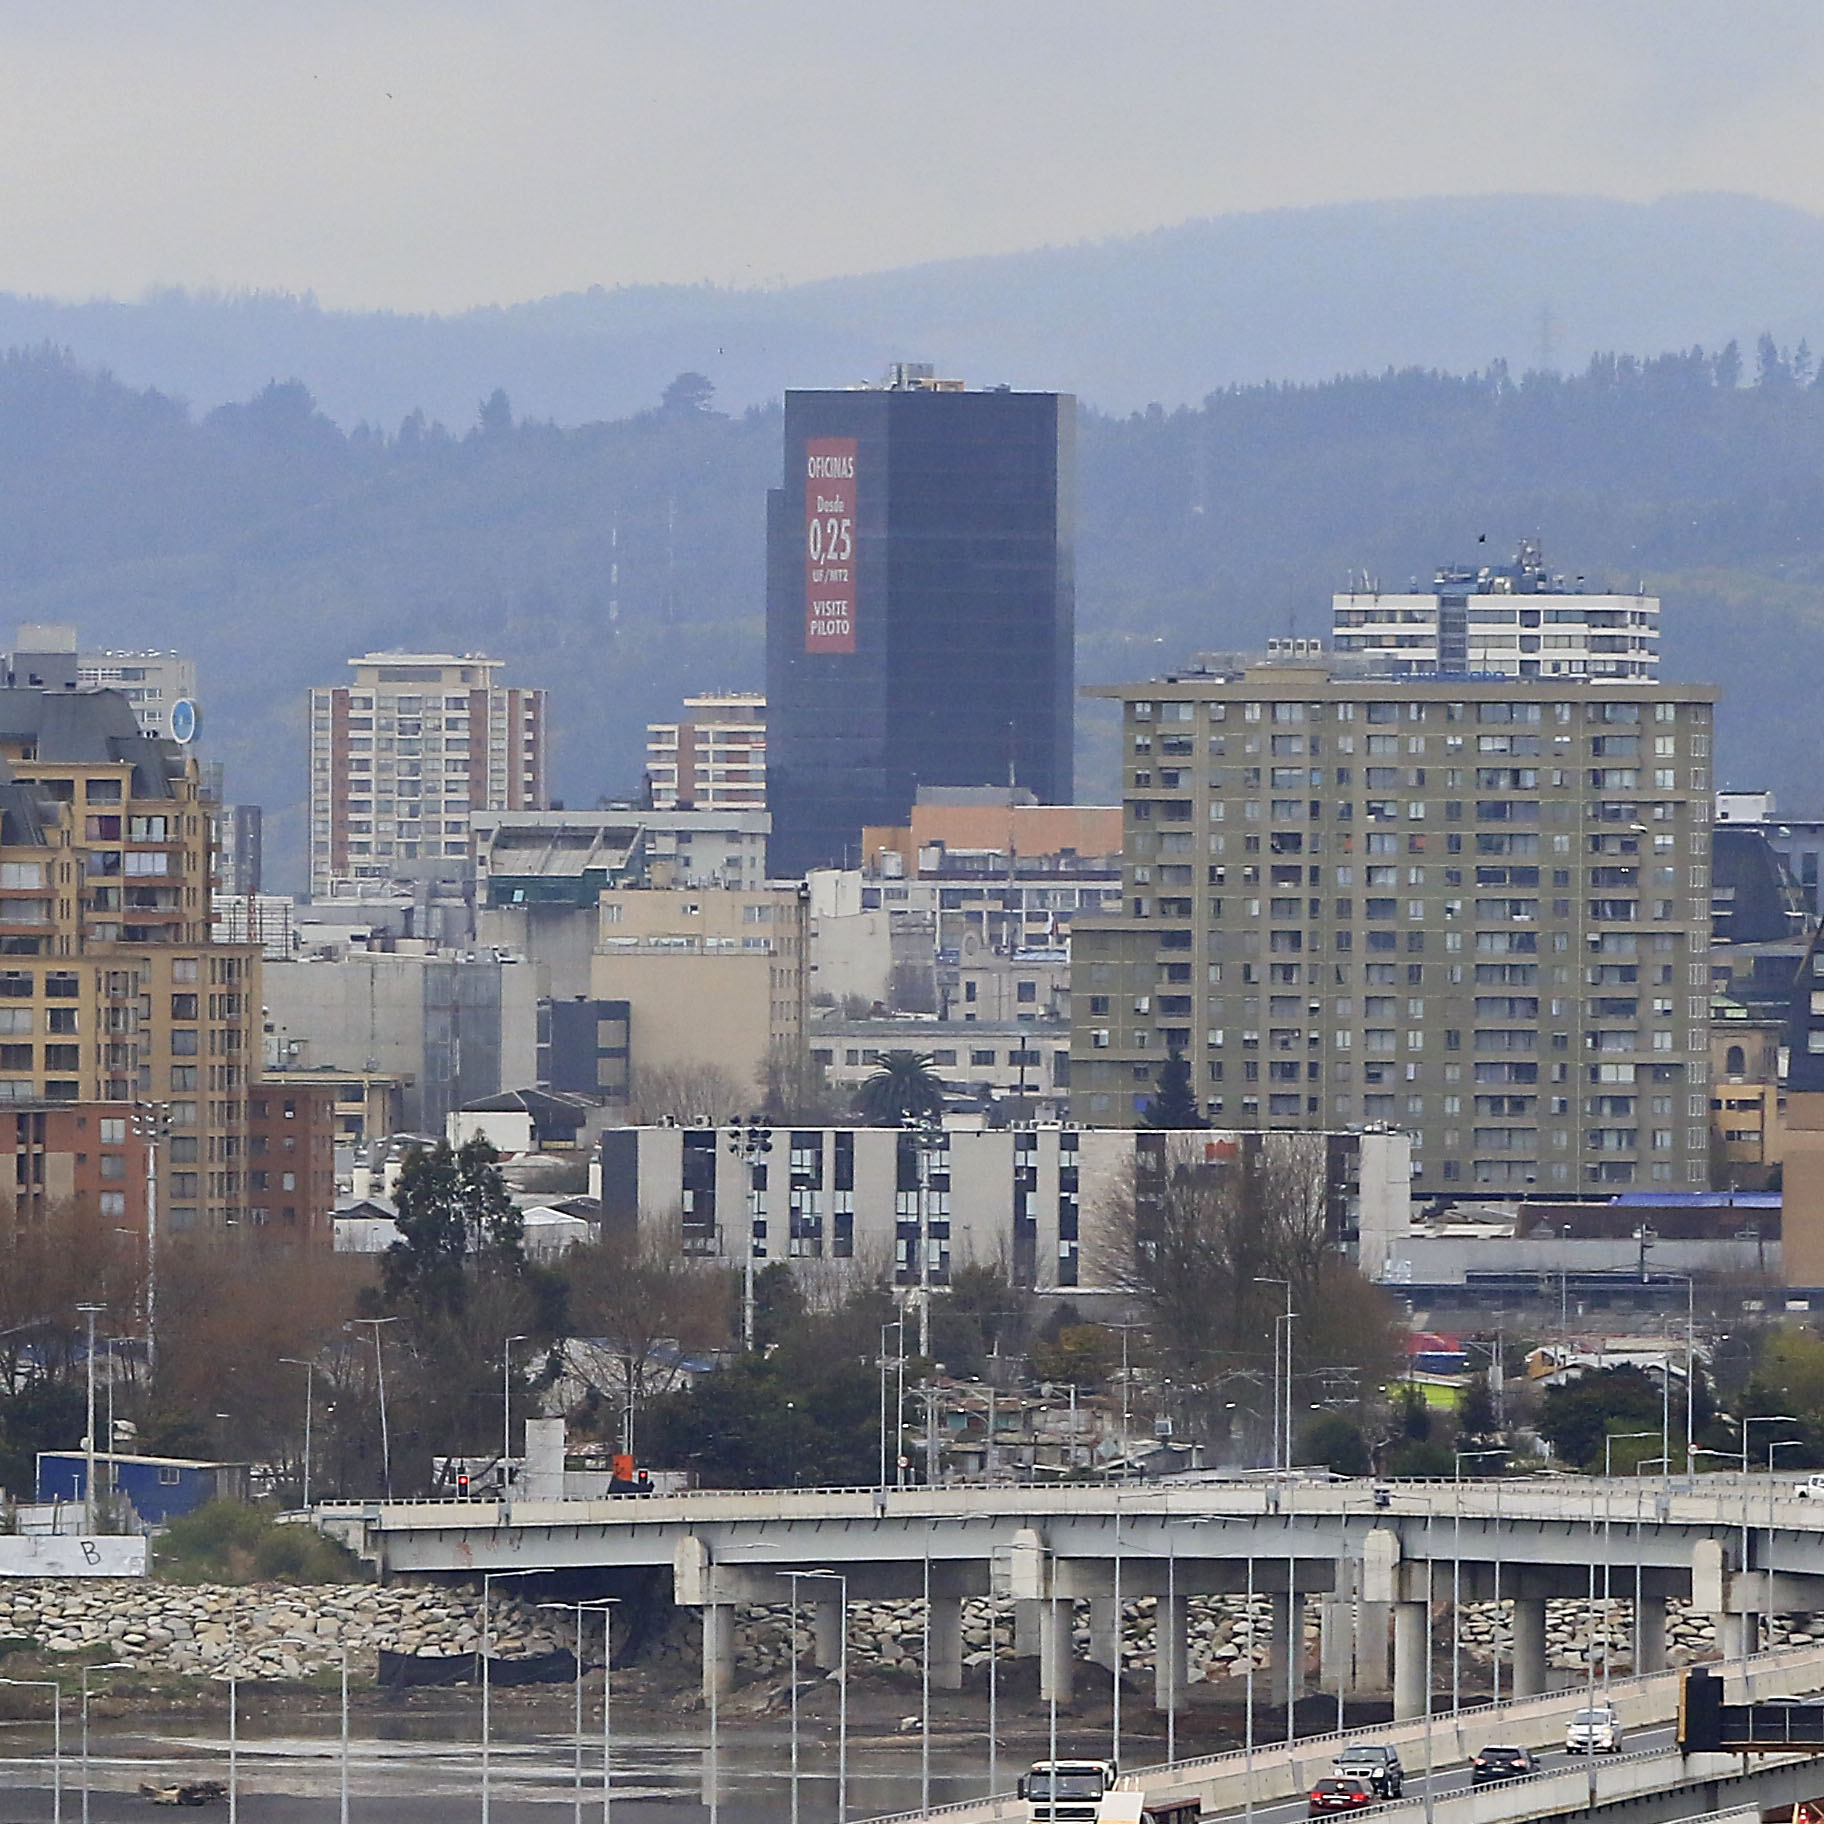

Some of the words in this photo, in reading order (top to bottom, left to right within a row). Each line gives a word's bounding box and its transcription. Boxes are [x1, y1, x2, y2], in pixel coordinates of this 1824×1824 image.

[808, 455, 855, 479] OFICINAS
[816, 493, 845, 513] Desde
[809, 517, 852, 566] 0,25
[812, 600, 849, 616] VISITE
[809, 619, 851, 636] PILOTO
[79, 1540, 101, 1566] B
